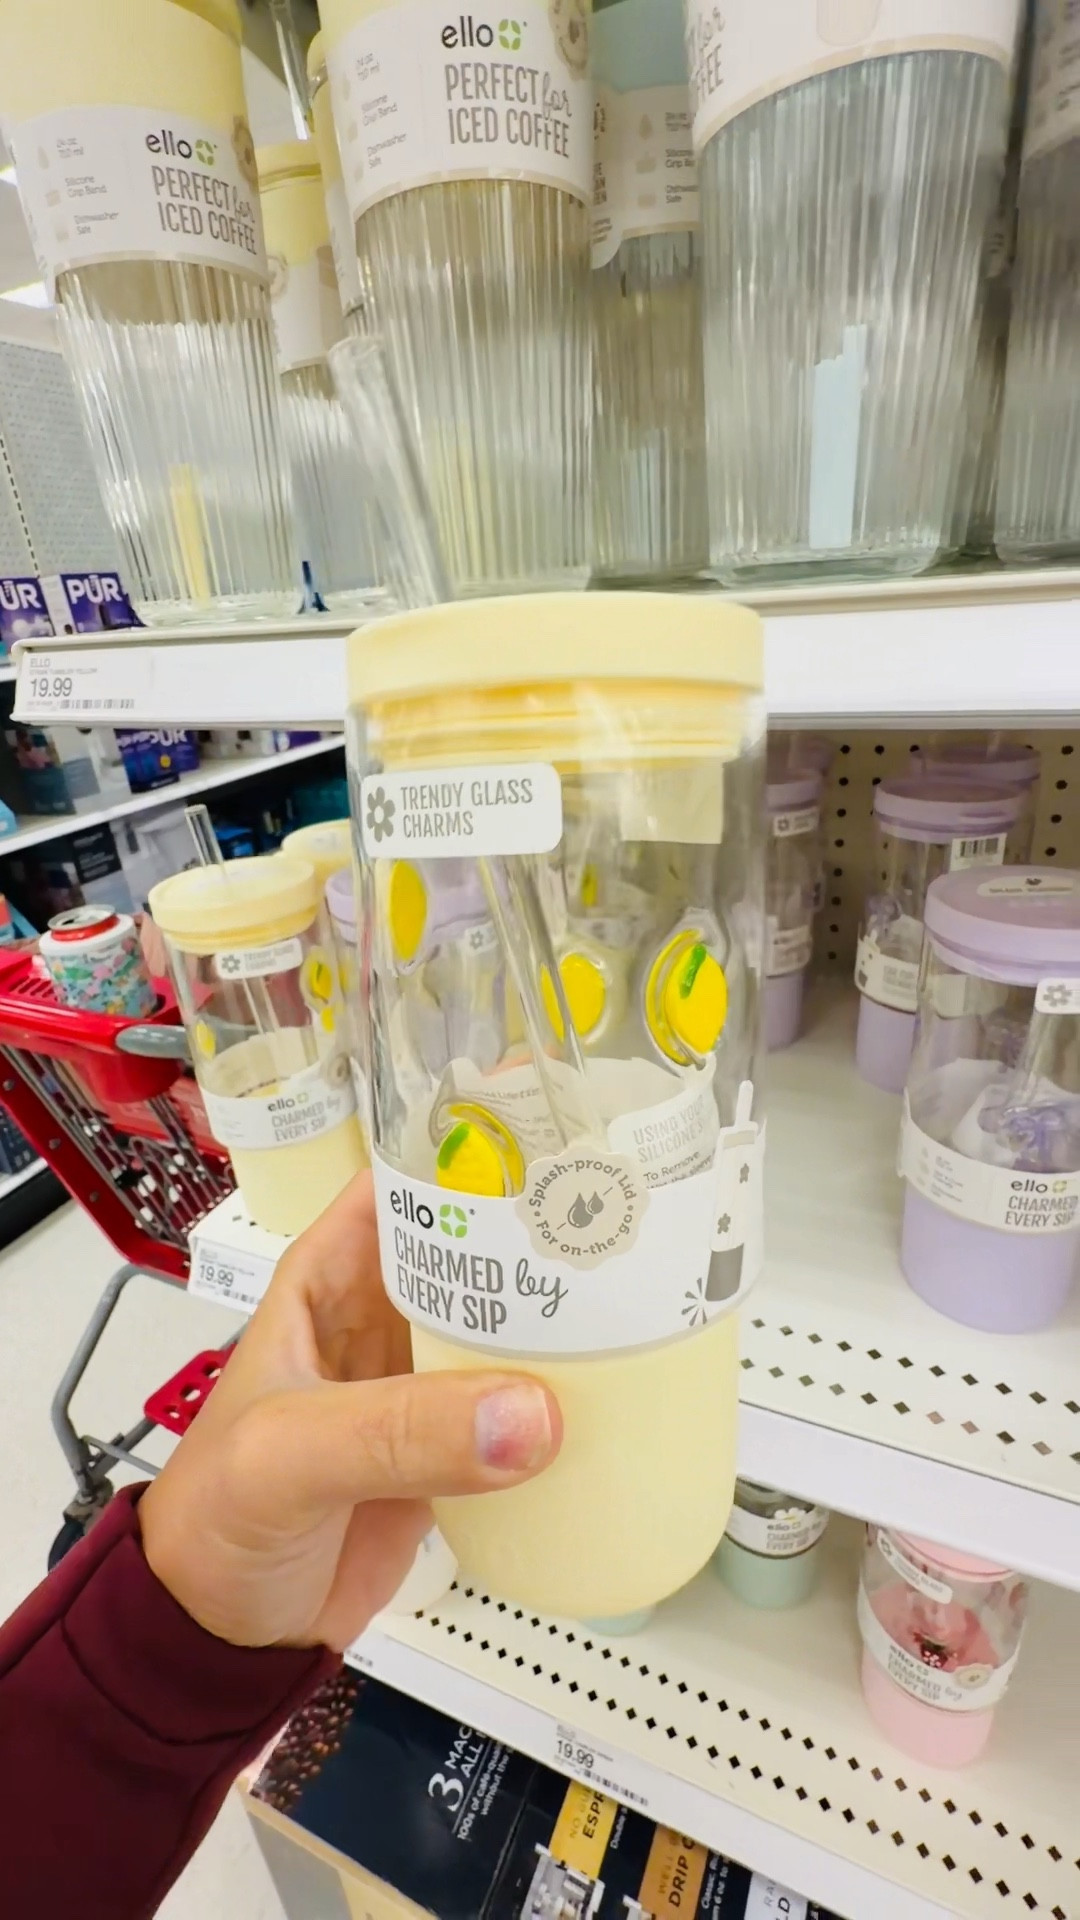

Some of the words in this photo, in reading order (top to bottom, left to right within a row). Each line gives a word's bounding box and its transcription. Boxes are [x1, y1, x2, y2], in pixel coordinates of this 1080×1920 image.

[441, 15, 494, 49] ello
[444, 63, 539, 105] PERFECT
[145, 129, 193, 159] ello
[448, 107, 498, 144] ICED
[506, 108, 569, 158] COFFEE
[151, 165, 229, 211] PERFECT
[157, 201, 204, 236] ICED
[208, 210, 257, 255] COFFEE
[31, 677, 73, 697] 19.99
[400, 782, 464, 810] TRENDY
[471, 778, 533, 806] GLASS
[402, 811, 474, 839] CHARMS
[267, 1097, 296, 1112] ello
[632, 1115, 679, 1145] USING
[529, 1159, 622, 1208] Splash-proof
[618, 1174, 637, 1201] Lid
[1010, 1179, 1048, 1194] ello
[390, 1188, 434, 1229] ello
[1005, 1210, 1051, 1227] EVERY
[536, 1220, 558, 1245] For
[560, 1214, 633, 1256] on-the-go
[199, 1264, 234, 1287] 19.99
[394, 1225, 504, 1294] CHARMED
[515, 1258, 569, 1318] by
[397, 1263, 454, 1323] EVERY
[462, 1294, 507, 1334] SIP
[461, 1743, 484, 1778] ALL
[557, 1740, 594, 1768] 19.99
[428, 1772, 464, 1812] 3
[481, 1774, 502, 1816] without
[668, 1855, 690, 1908] DRIP
